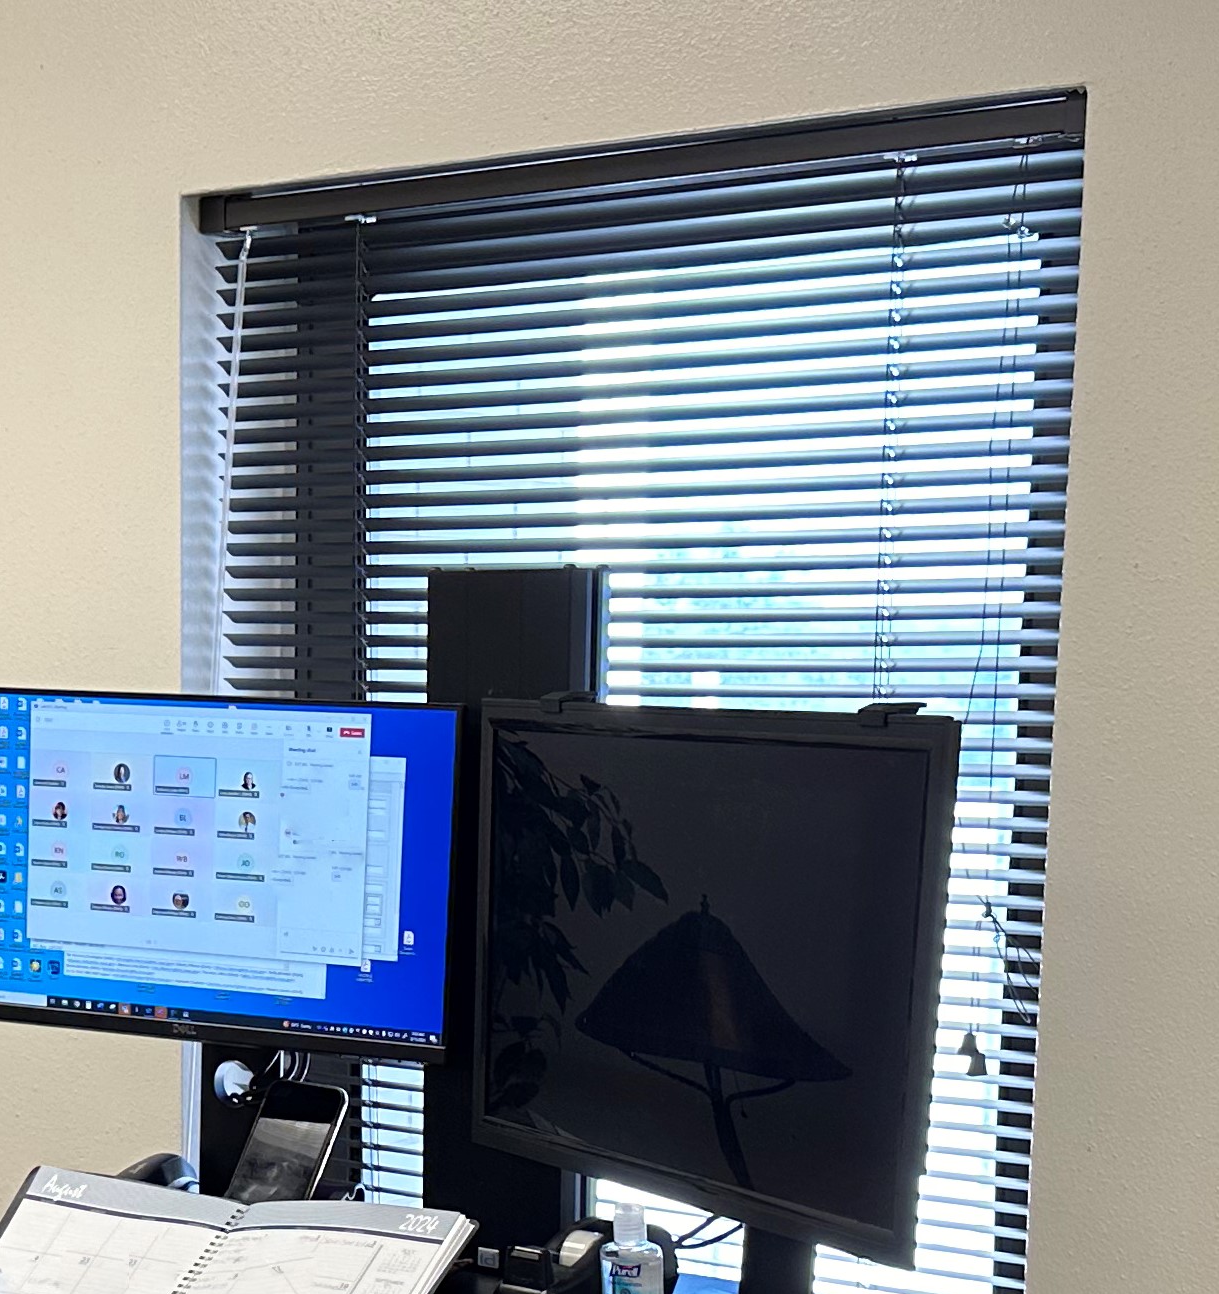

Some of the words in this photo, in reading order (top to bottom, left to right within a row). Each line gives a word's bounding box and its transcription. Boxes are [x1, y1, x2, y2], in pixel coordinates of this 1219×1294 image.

[173, 1023, 197, 1036] DELL
[40, 1174, 89, 1201] August
[398, 1213, 439, 1235] 2024
